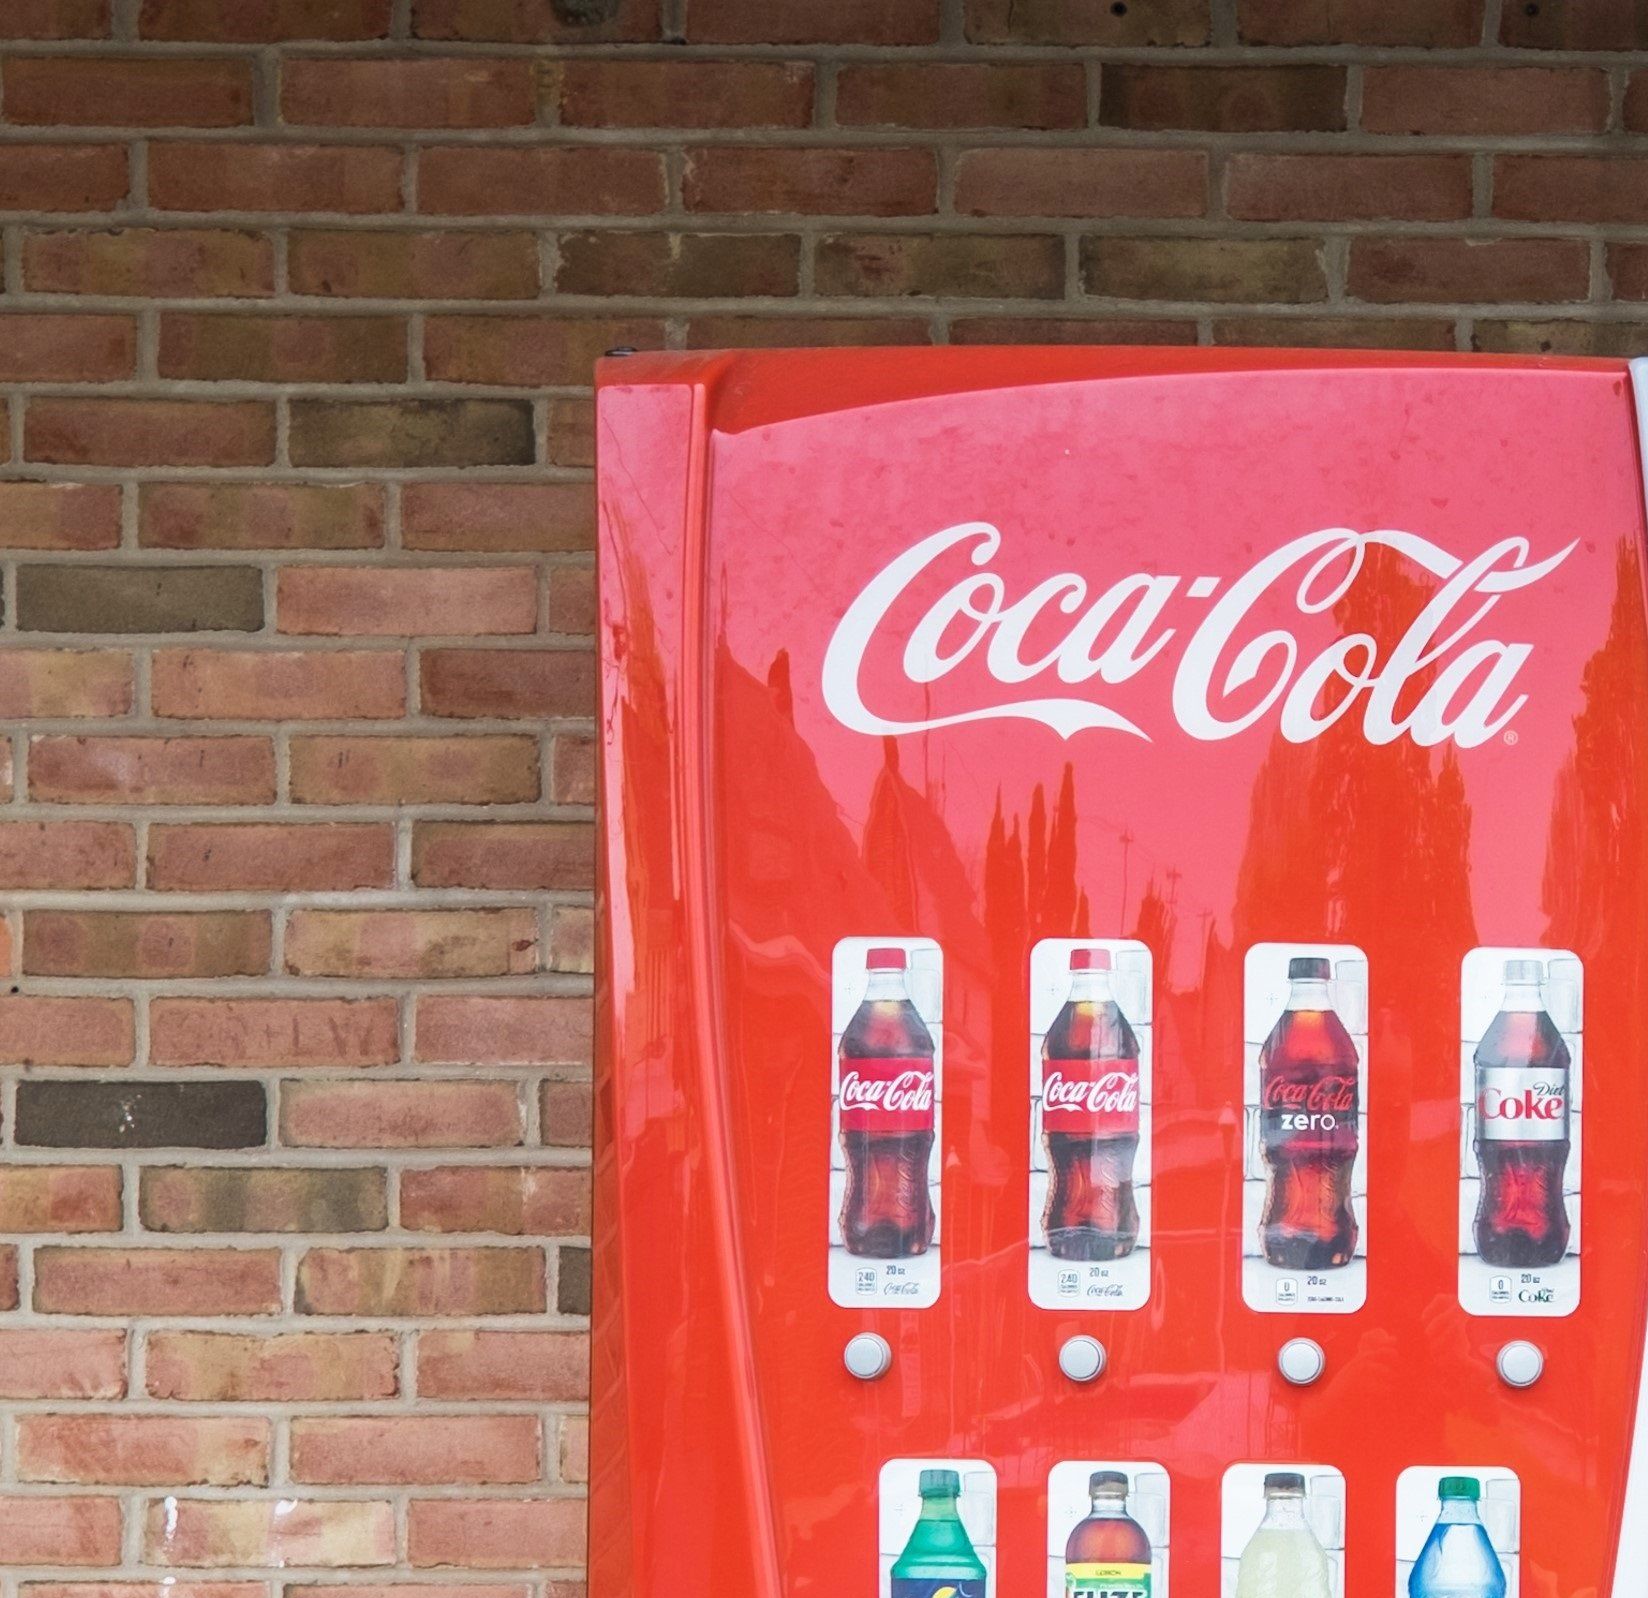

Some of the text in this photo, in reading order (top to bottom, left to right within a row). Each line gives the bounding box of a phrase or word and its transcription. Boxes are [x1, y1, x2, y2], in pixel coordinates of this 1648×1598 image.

[821, 521, 1580, 748] Coca-Cola
[840, 1071, 934, 1111] Coca-Cola
[1043, 1071, 1139, 1112] Coca-Cola
[1478, 1087, 1564, 1121] Coke
[1533, 1081, 1565, 1097] Diet
[1280, 1114, 1336, 1131] zero
